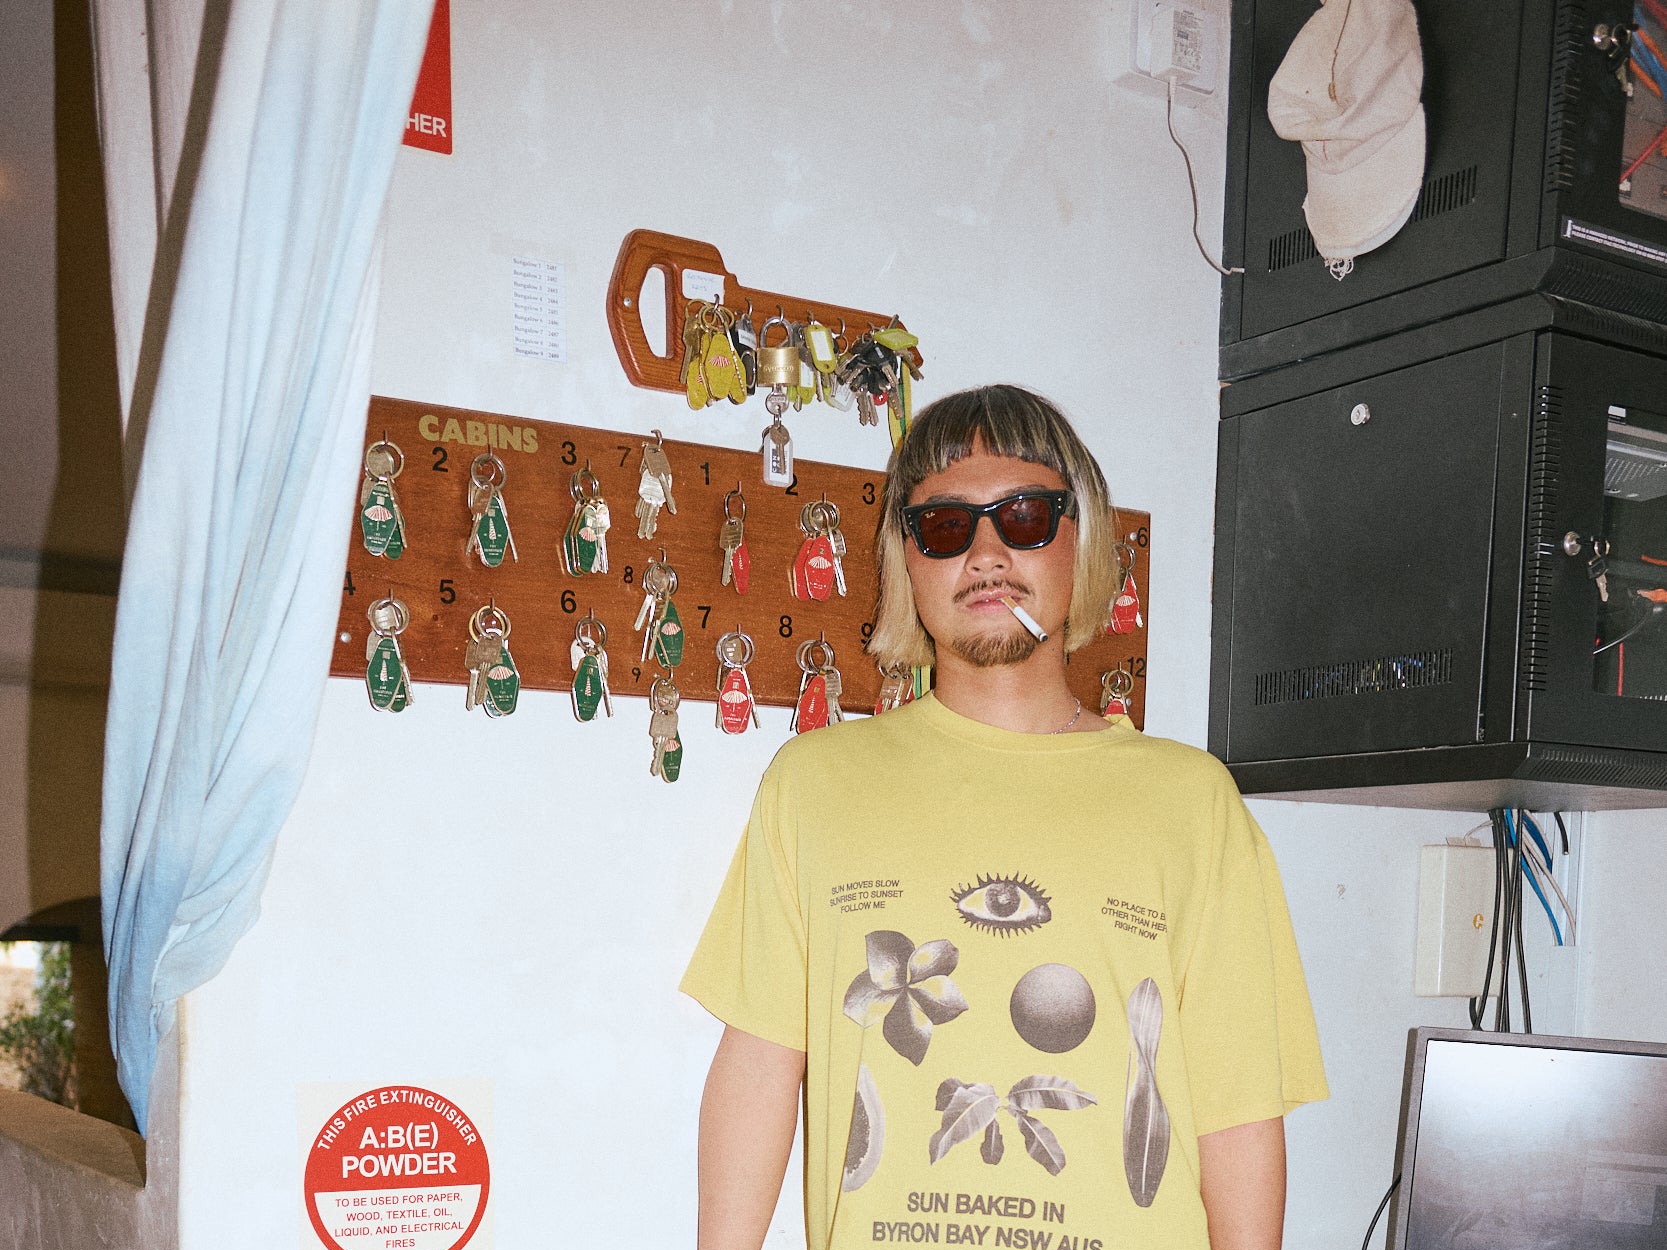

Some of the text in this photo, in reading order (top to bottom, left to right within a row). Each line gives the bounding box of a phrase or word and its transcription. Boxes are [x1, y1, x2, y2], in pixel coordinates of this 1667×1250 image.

[406, 112, 447, 138] HER
[418, 414, 538, 454] CABINS
[432, 446, 448, 472] 2
[561, 441, 577, 465] 3
[618, 446, 631, 467] 7
[700, 462, 710, 485] 1
[862, 482, 875, 505] 3
[1136, 527, 1148, 548] 6
[624, 566, 633, 584] 8
[439, 580, 456, 604] 5
[561, 590, 577, 614] 6
[697, 606, 711, 629] 7
[778, 615, 793, 638] 8
[631, 667, 642, 682] 9
[1127, 657, 1146, 678] 12
[830, 893, 857, 907] SUNRISE
[871, 890, 904, 898] SUNSET
[832, 884, 844, 895] SUN
[846, 880, 873, 891] MOVES
[841, 901, 871, 913] FOLLOW
[1101, 907, 1128, 920] OTHER
[1130, 914, 1150, 927] THAN
[1107, 897, 1119, 906] NO
[1121, 901, 1145, 915] PLACE
[1147, 909, 1158, 918] TO
[1114, 921, 1158, 940] RIGHT NOW
[317, 1090, 477, 1151] THIS FIRE EXTINGUISHER
[359, 1122, 438, 1150] A:B(E)
[342, 1152, 457, 1178] POWDER
[335, 1193, 463, 1207] TO BE USED FOR PAPER,
[907, 1192, 1065, 1224] SUN BAKED IN
[346, 1208, 453, 1222] WOOD, TEXTILE, OIL,
[334, 1221, 464, 1237] LIQUID, AND ELECTRICAL
[872, 1221, 939, 1243] BYRON
[946, 1224, 990, 1245] BAY
[385, 1239, 415, 1248] FIRES
